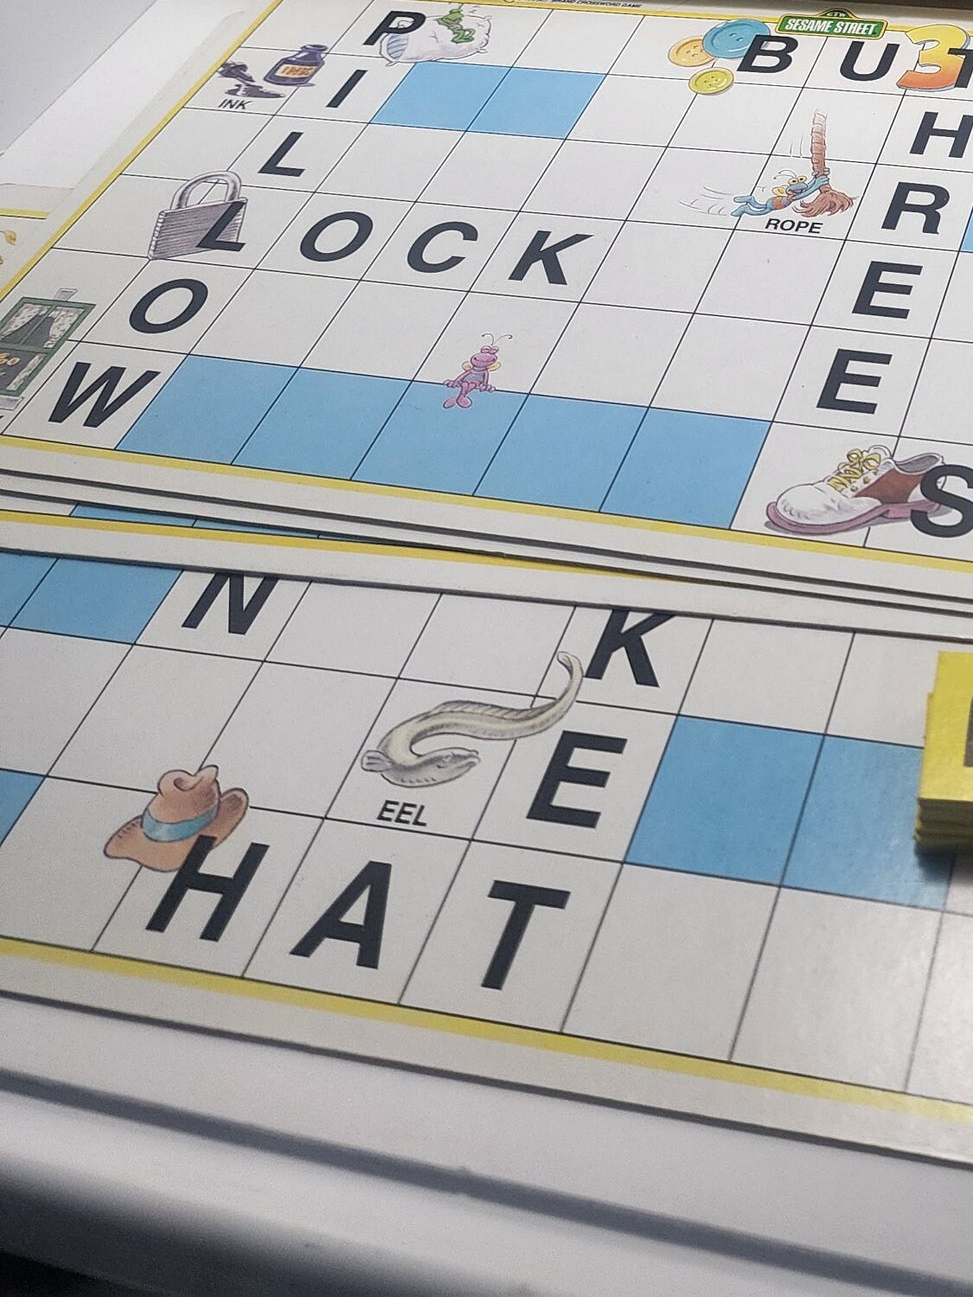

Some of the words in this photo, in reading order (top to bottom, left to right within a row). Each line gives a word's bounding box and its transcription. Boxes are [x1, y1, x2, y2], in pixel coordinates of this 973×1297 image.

[785, 18, 834, 33] SESAME
[834, 21, 878, 35] STREET
[895, 23, 970, 92] 3
[218, 98, 253, 110] INK
[764, 215, 824, 234] ROPE
[377, 799, 428, 829] EEL
